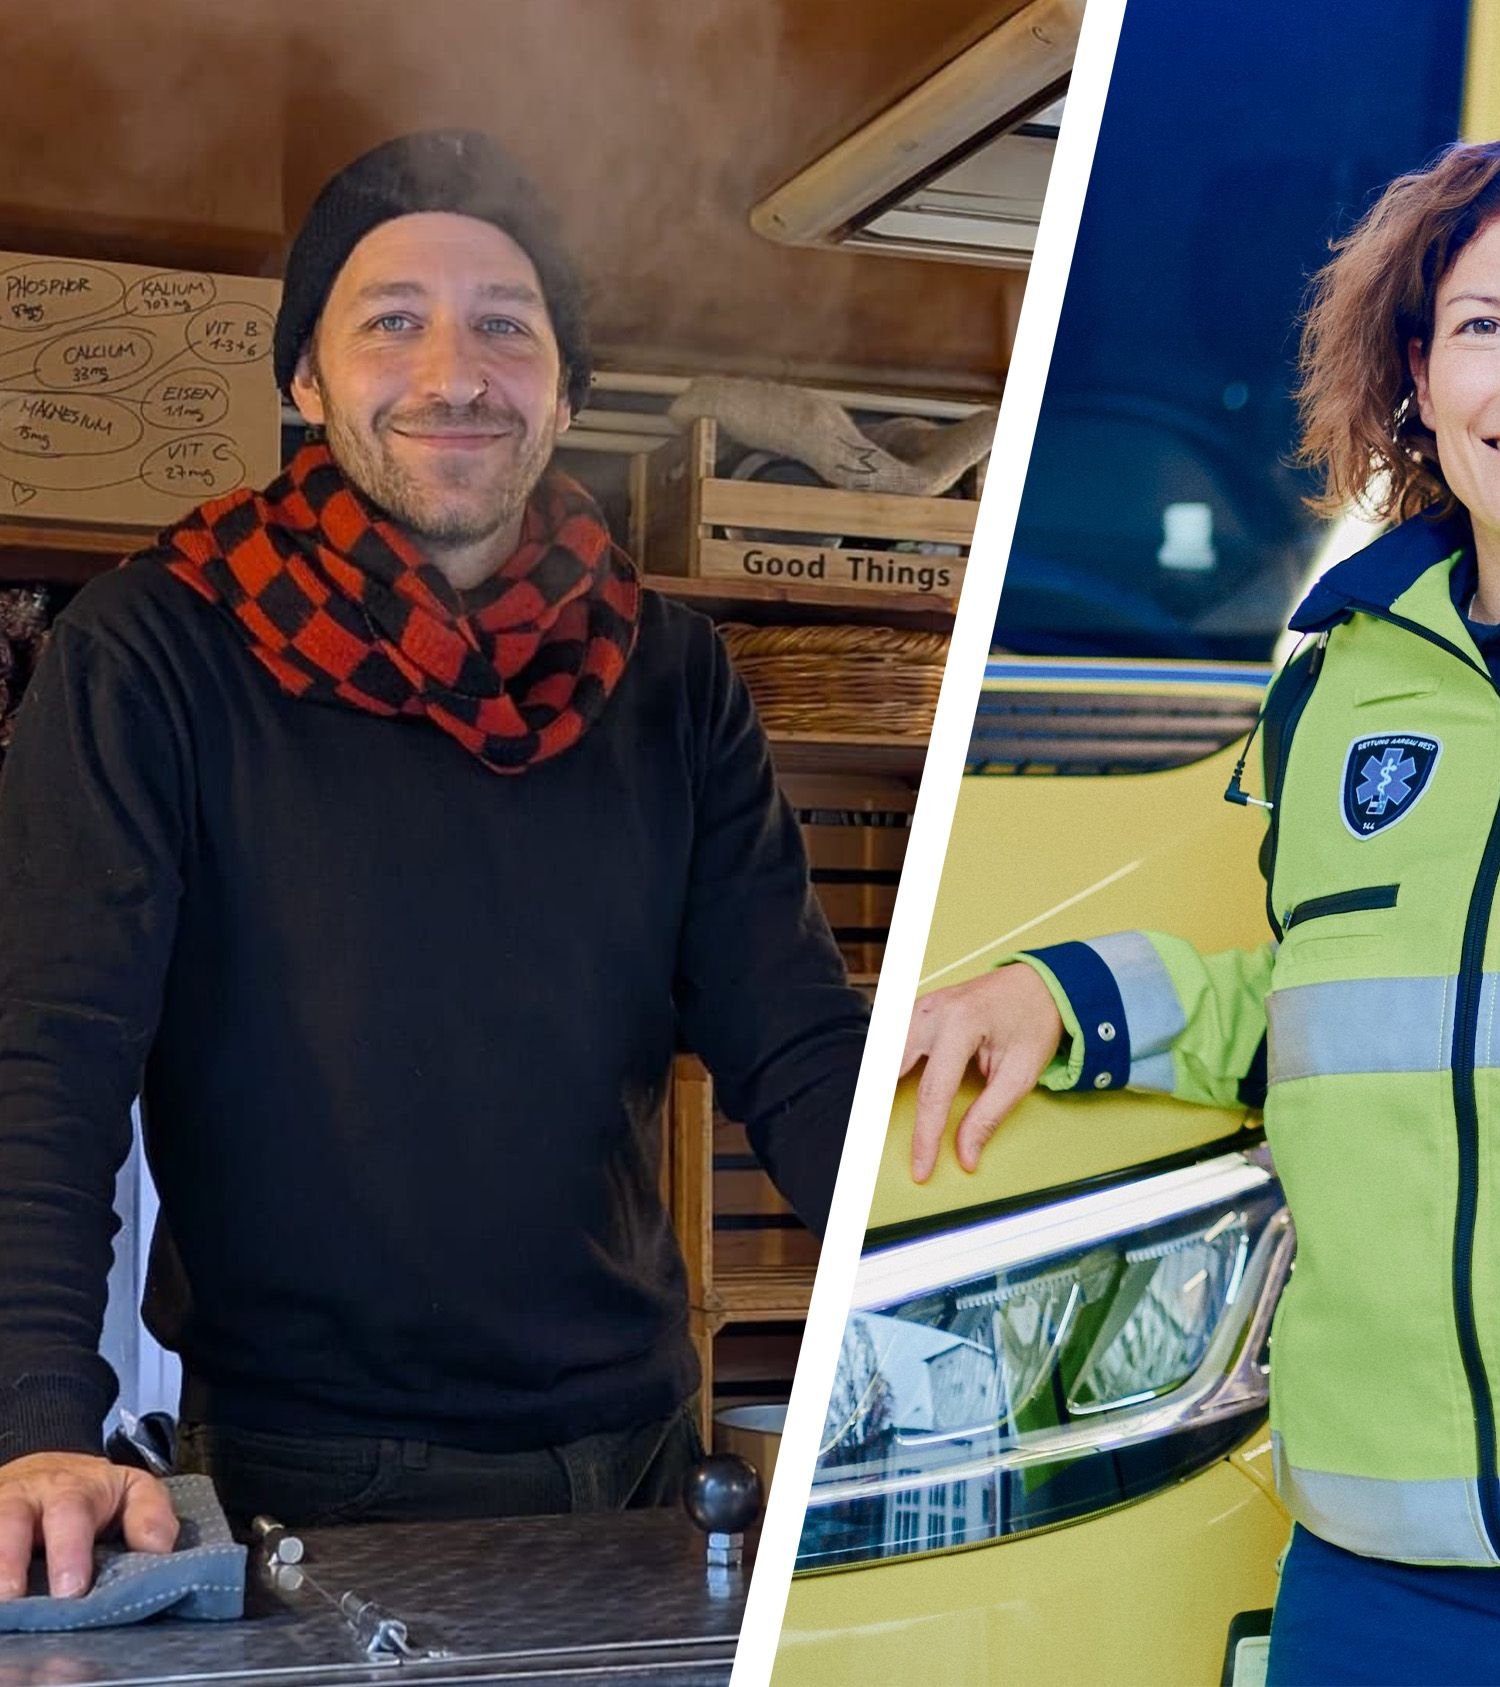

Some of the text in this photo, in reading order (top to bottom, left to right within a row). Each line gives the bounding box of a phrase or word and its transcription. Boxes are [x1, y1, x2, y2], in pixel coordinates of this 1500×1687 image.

[6, 275, 92, 301] PHOSPHOR
[141, 282, 205, 297] KALIUM
[206, 321, 259, 337] VIT B
[63, 342, 136, 365] CALCIUM
[162, 386, 221, 401] EISEN
[19, 399, 112, 435] MAGNESIUM
[168, 443, 229, 461] VIT C
[743, 550, 950, 592] Good Things
[1358, 739, 1390, 751] RETTUNG
